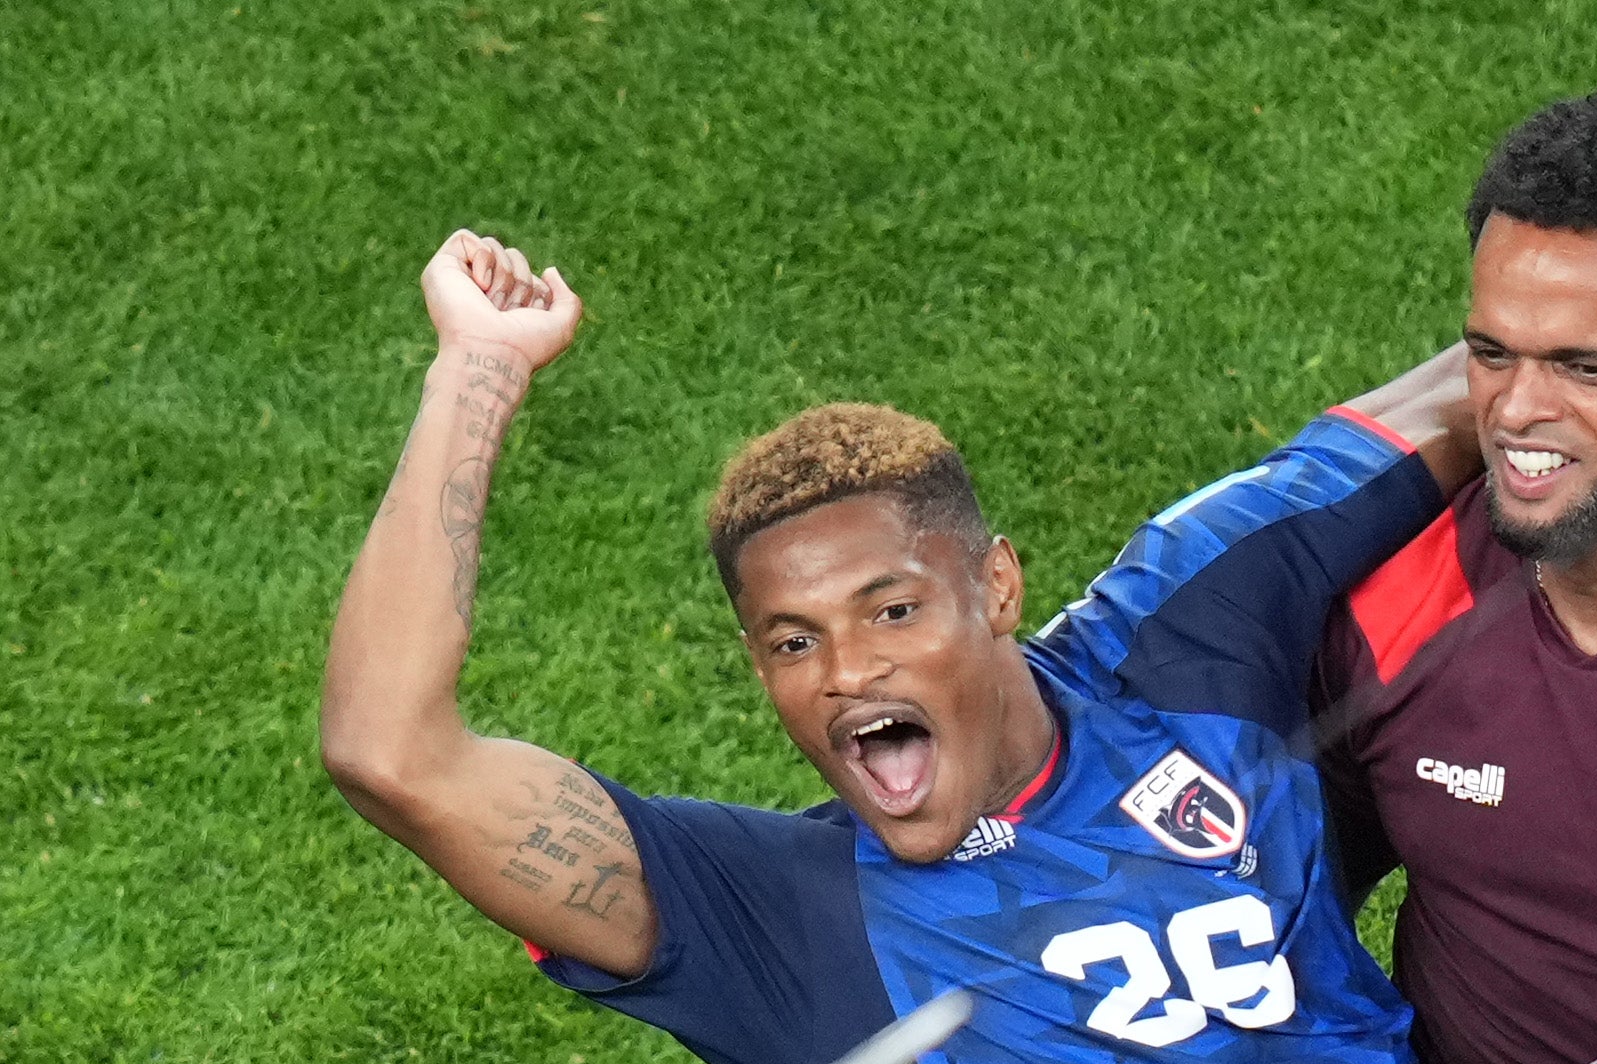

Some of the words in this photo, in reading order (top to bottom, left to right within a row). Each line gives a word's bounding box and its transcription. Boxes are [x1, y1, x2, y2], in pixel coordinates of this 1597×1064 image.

[1132, 759, 1179, 812] FCF
[1415, 757, 1506, 796] capelli
[1454, 786, 1503, 808] SPORT
[953, 834, 1017, 862] SPORT
[960, 815, 1015, 849] elli
[1040, 893, 1297, 1048] 26
